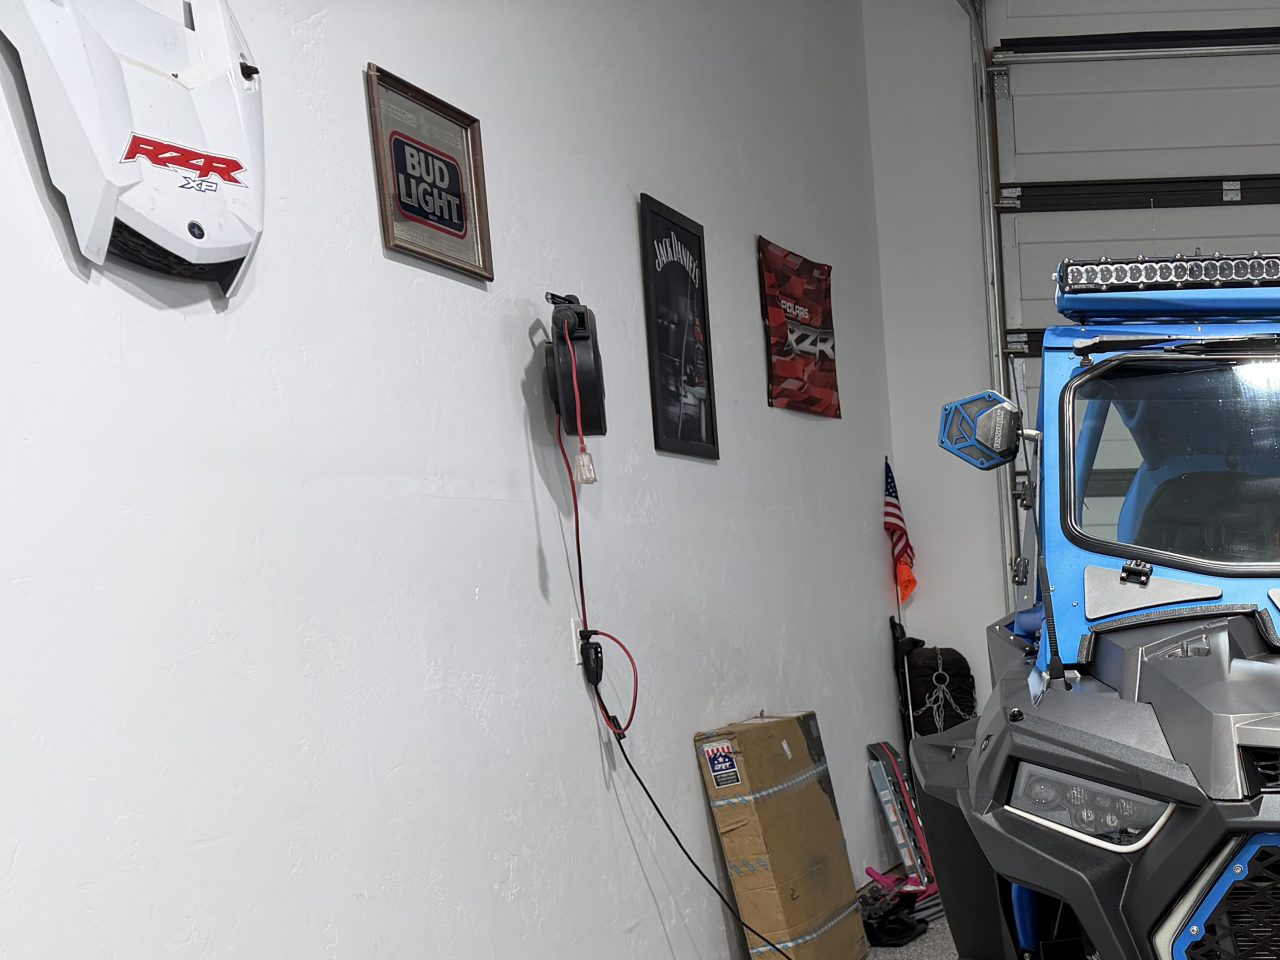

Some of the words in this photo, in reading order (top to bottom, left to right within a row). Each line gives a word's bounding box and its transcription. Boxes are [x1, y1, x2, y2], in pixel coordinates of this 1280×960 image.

[120, 132, 247, 187] RZR
[404, 145, 449, 189] BUD
[178, 176, 217, 192] XP
[399, 173, 460, 224] LIGHT
[654, 238, 673, 271] JACK
[780, 300, 809, 318] POLARIS
